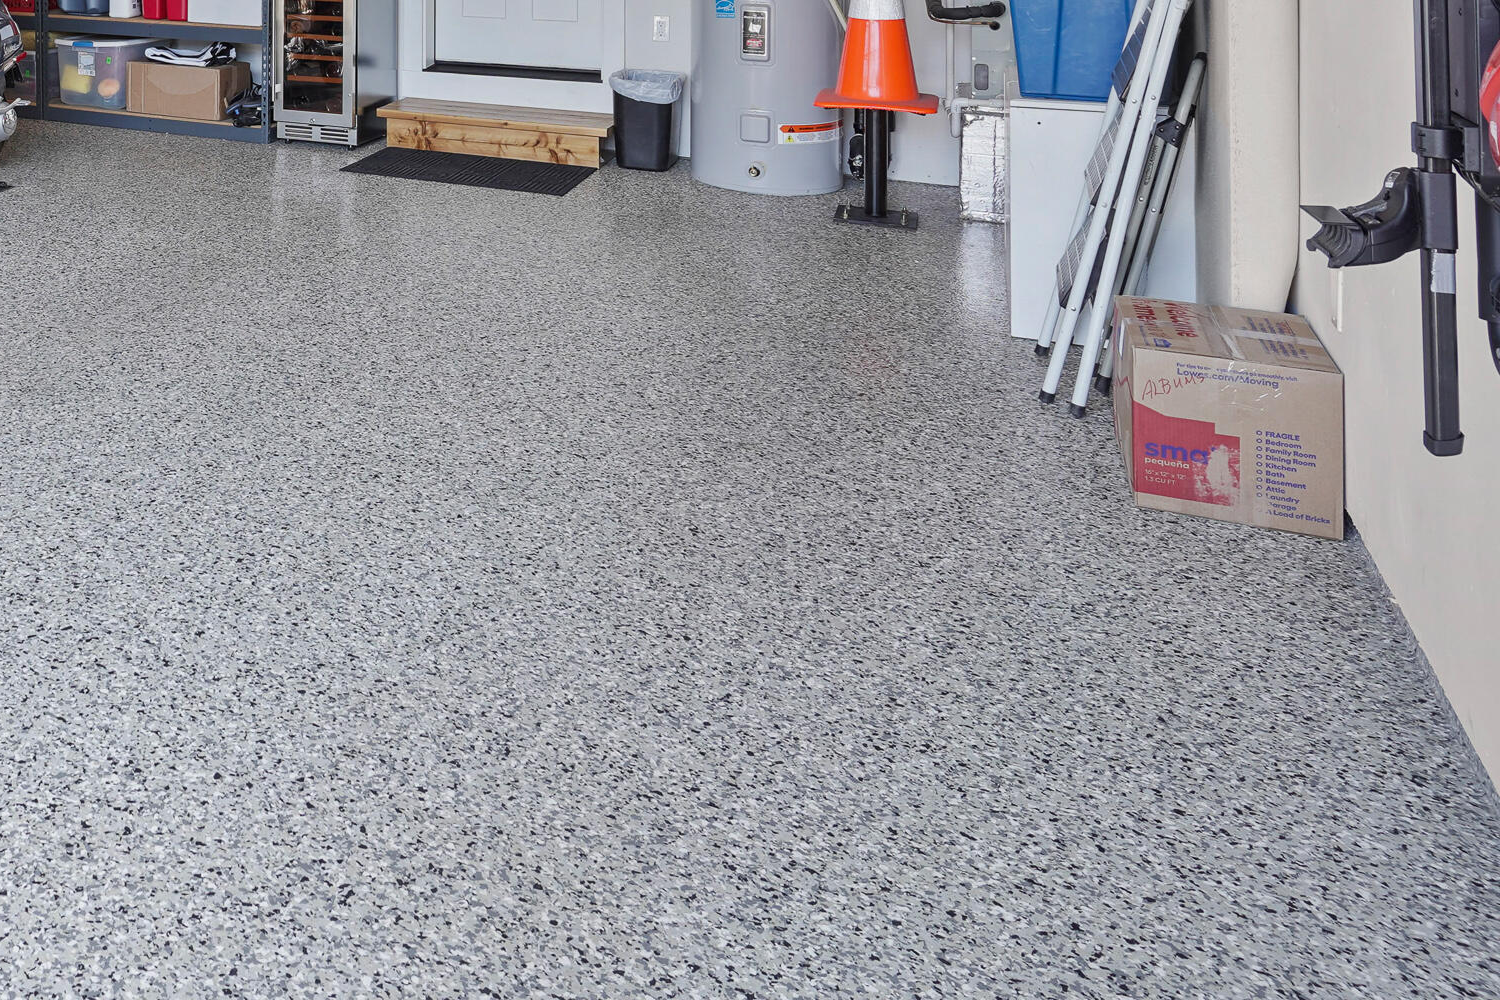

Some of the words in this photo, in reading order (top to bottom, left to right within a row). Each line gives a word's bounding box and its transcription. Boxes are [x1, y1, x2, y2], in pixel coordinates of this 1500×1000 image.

[1142, 376, 1205, 401] ALBUMS
[1265, 431, 1301, 442] FRAGILE
[1265, 439, 1302, 450] Bedroom
[1265, 447, 1292, 457] Family
[1293, 450, 1317, 460] Room
[1144, 457, 1190, 469] pequeña
[1265, 454, 1292, 465] Dining
[1292, 458, 1317, 468] Room
[1265, 462, 1297, 473] Kitchen
[1265, 470, 1285, 478] Bath
[1265, 478, 1307, 490] Basement
[1265, 486, 1286, 494] Attic
[1273, 509, 1294, 519] Load
[1305, 514, 1331, 524] Bricks
